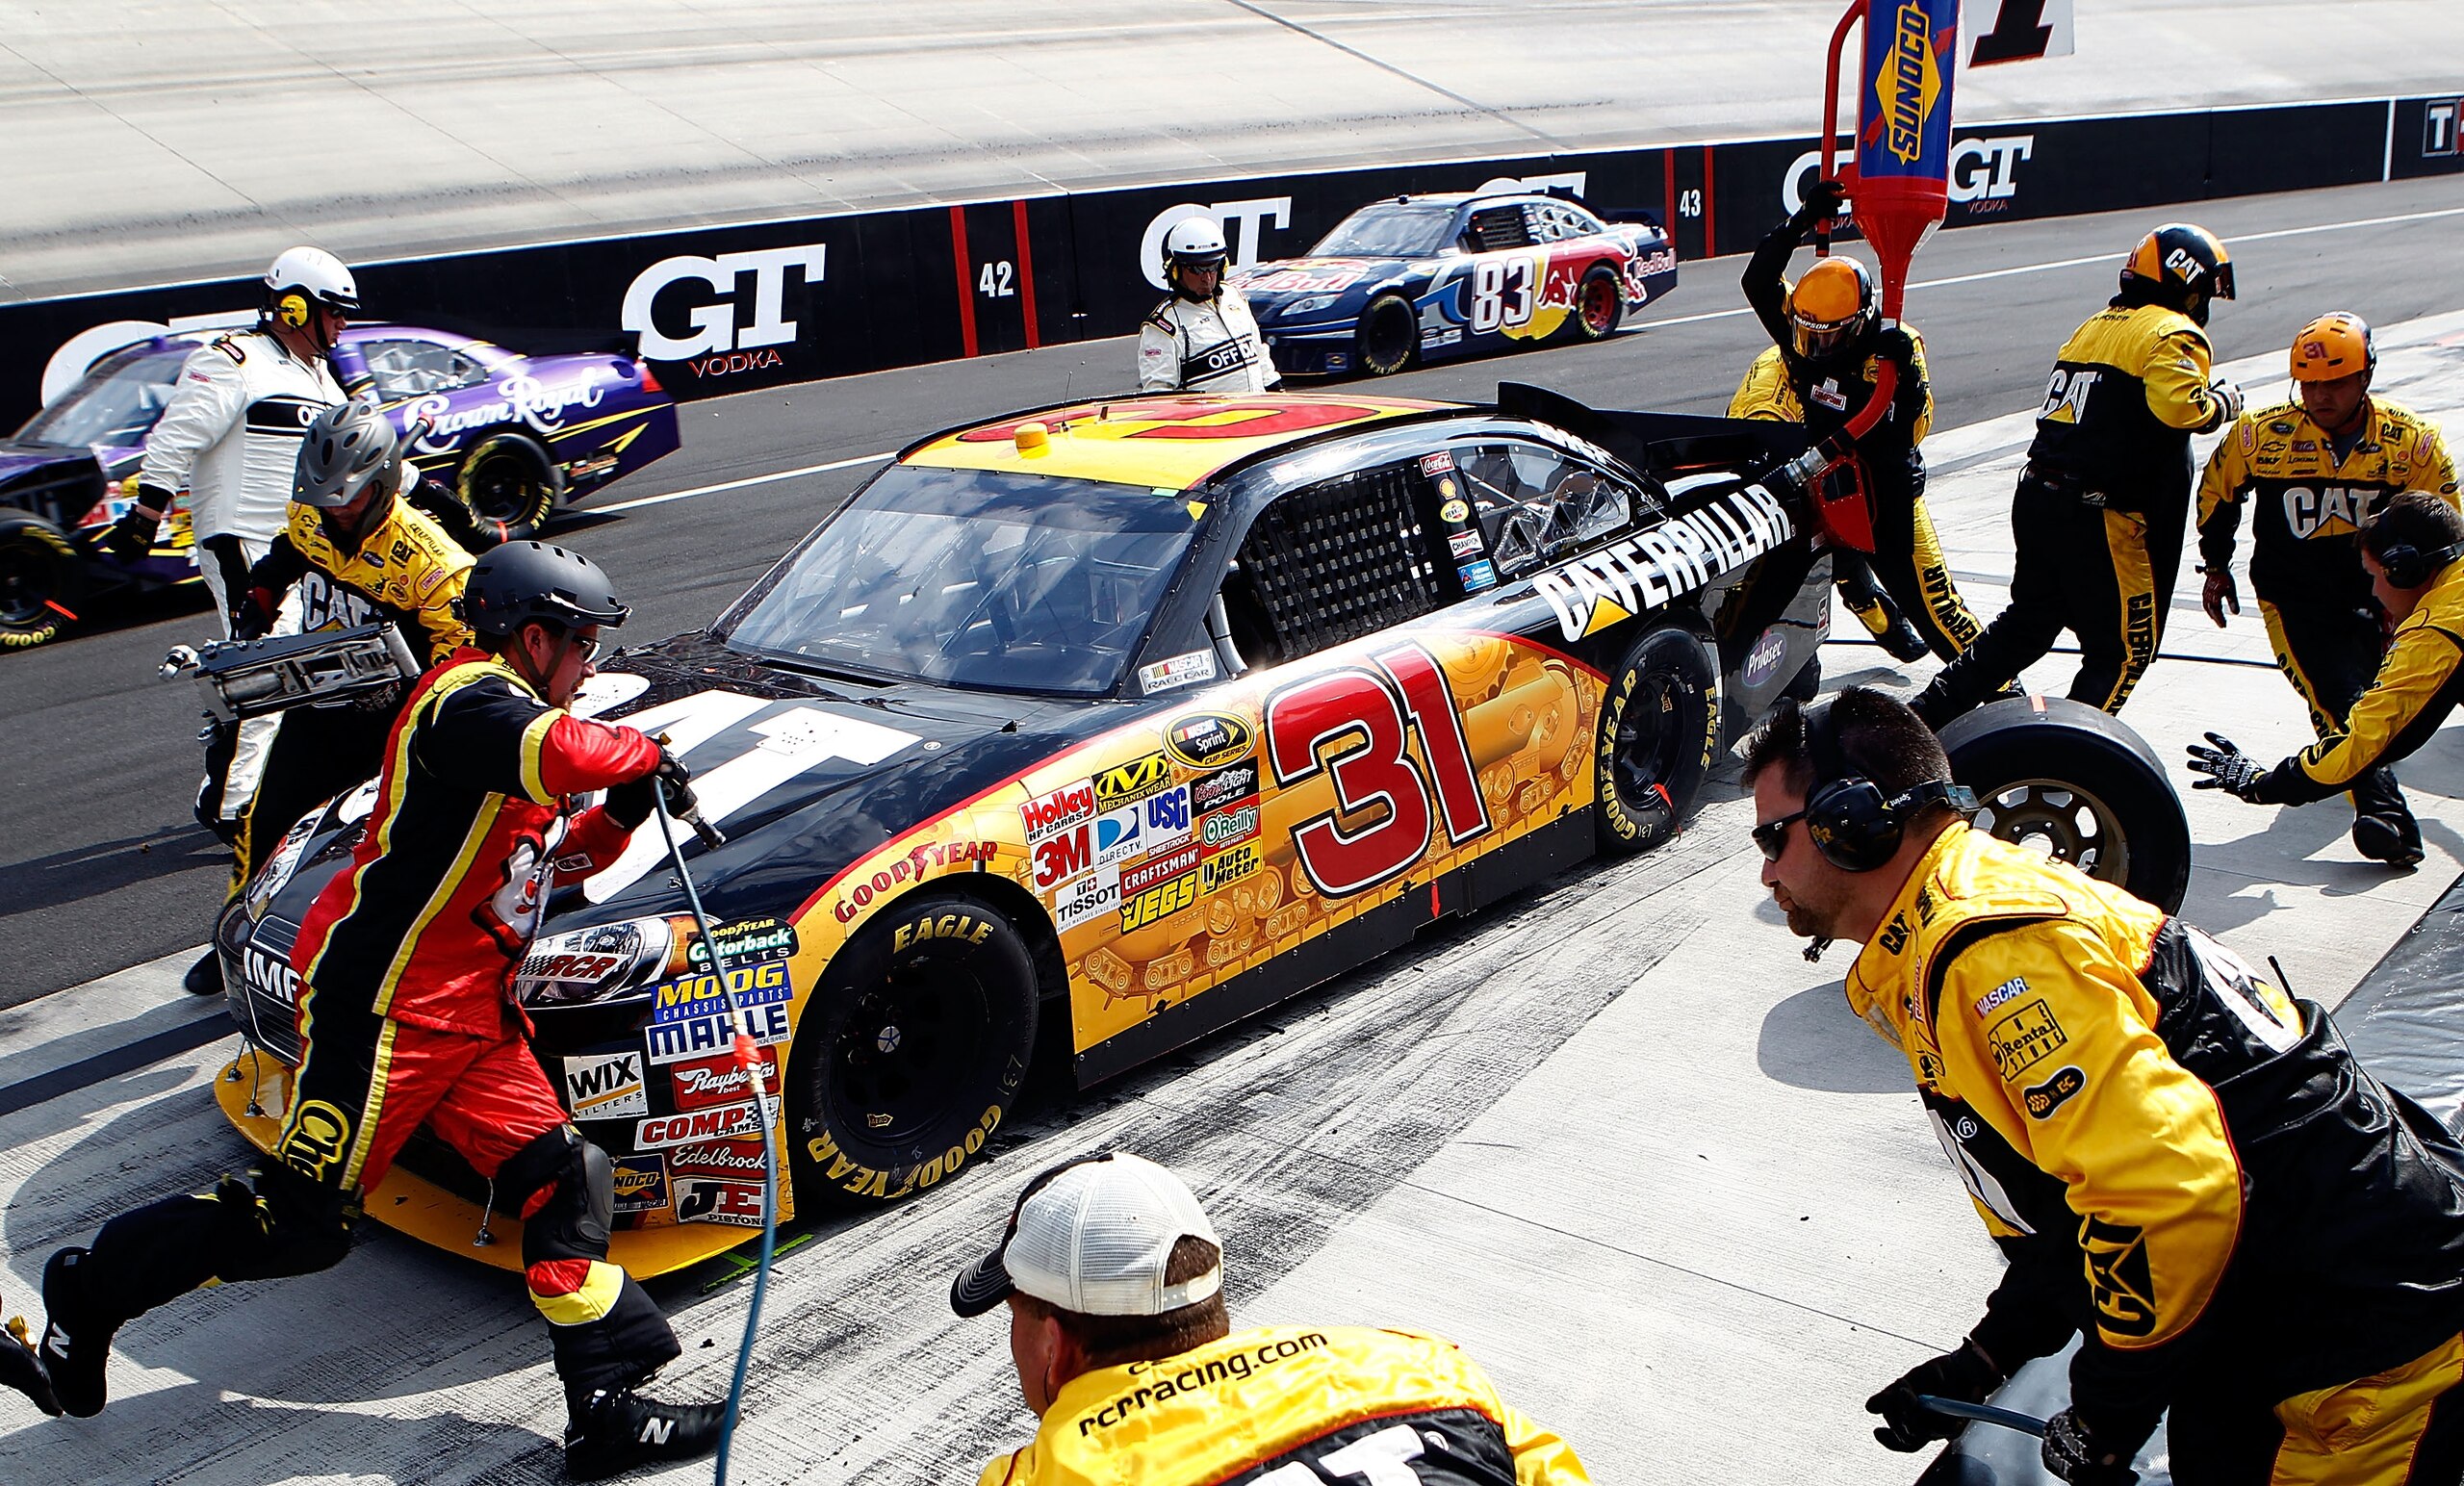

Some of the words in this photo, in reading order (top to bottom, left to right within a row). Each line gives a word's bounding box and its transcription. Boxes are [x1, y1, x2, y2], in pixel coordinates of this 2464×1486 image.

[1892, 10, 1927, 157] SUNOCO
[1950, 135, 2034, 202] GT
[1680, 189, 1701, 217] 43
[1966, 199, 2008, 215] VODKA
[979, 261, 1014, 297] 42
[2166, 247, 2204, 285] CAT
[622, 243, 827, 361] GT
[1471, 256, 1536, 334] 83
[1793, 315, 1829, 330] SIMPSON
[687, 348, 783, 378] VODKA
[403, 394, 513, 453] Crown
[498, 367, 604, 433] Royal
[1813, 389, 1843, 407] SIMPSON
[2037, 369, 2097, 424] CAT
[2283, 487, 2380, 541] CAT
[391, 540, 418, 562] CAT
[1451, 538, 1479, 551] CHAMPION
[1532, 484, 1790, 642] CATERPILLAR
[303, 572, 372, 630] CAT
[1747, 638, 1783, 678] Prilosec
[1195, 730, 1227, 754] Sprint
[1700, 685, 1718, 772] EAGLE
[1204, 753, 1220, 766] CUP
[1220, 744, 1247, 759] SERIES
[1265, 638, 1491, 898] 31
[1601, 669, 1637, 840] GOODYEAR
[1098, 790, 1146, 813] MECHANIX
[1145, 776, 1171, 796] WEAR
[1204, 786, 1246, 809] POLE
[1221, 770, 1254, 792] LIGHT
[1021, 785, 1094, 833] Holley
[1029, 828, 1044, 842] HP
[1046, 811, 1084, 833] CARBS
[1147, 786, 1190, 832] USG
[1205, 807, 1258, 844] O'Reilly
[1035, 823, 1091, 887] 3M
[1097, 839, 1142, 866] DIRECTV
[1148, 833, 1192, 858] SHEETROCK
[1218, 847, 1251, 868] Auto
[834, 841, 998, 923] GOODYEAR
[1124, 848, 1196, 889] CRAFTSMAN
[1215, 858, 1259, 885] Meter
[1058, 883, 1119, 922] TISSOT
[1122, 872, 1197, 933] JEGS
[689, 928, 792, 961] Gtorback
[710, 919, 776, 937] OODYEAR
[893, 914, 995, 954] EAGLE
[1879, 912, 1911, 956] CAT
[551, 954, 618, 980] RCR
[700, 947, 790, 973] BELTS
[655, 962, 784, 1010] MOOG
[663, 998, 727, 1021] CHASSIS
[738, 989, 783, 1007] PARTS
[1976, 976, 2029, 1017] NASCAR
[2002, 1018, 2056, 1057] Rental
[567, 1054, 639, 1100] WIX
[723, 1084, 740, 1093] best
[643, 1107, 746, 1143] COMP
[713, 1120, 762, 1137] CAMS
[672, 1144, 767, 1169] Edelbrock
[807, 1105, 1002, 1199] GOODYEAR
[613, 1174, 658, 1188] NOCO
[679, 1182, 762, 1220] JE
[1078, 1333, 1328, 1438] rcrracing.com
